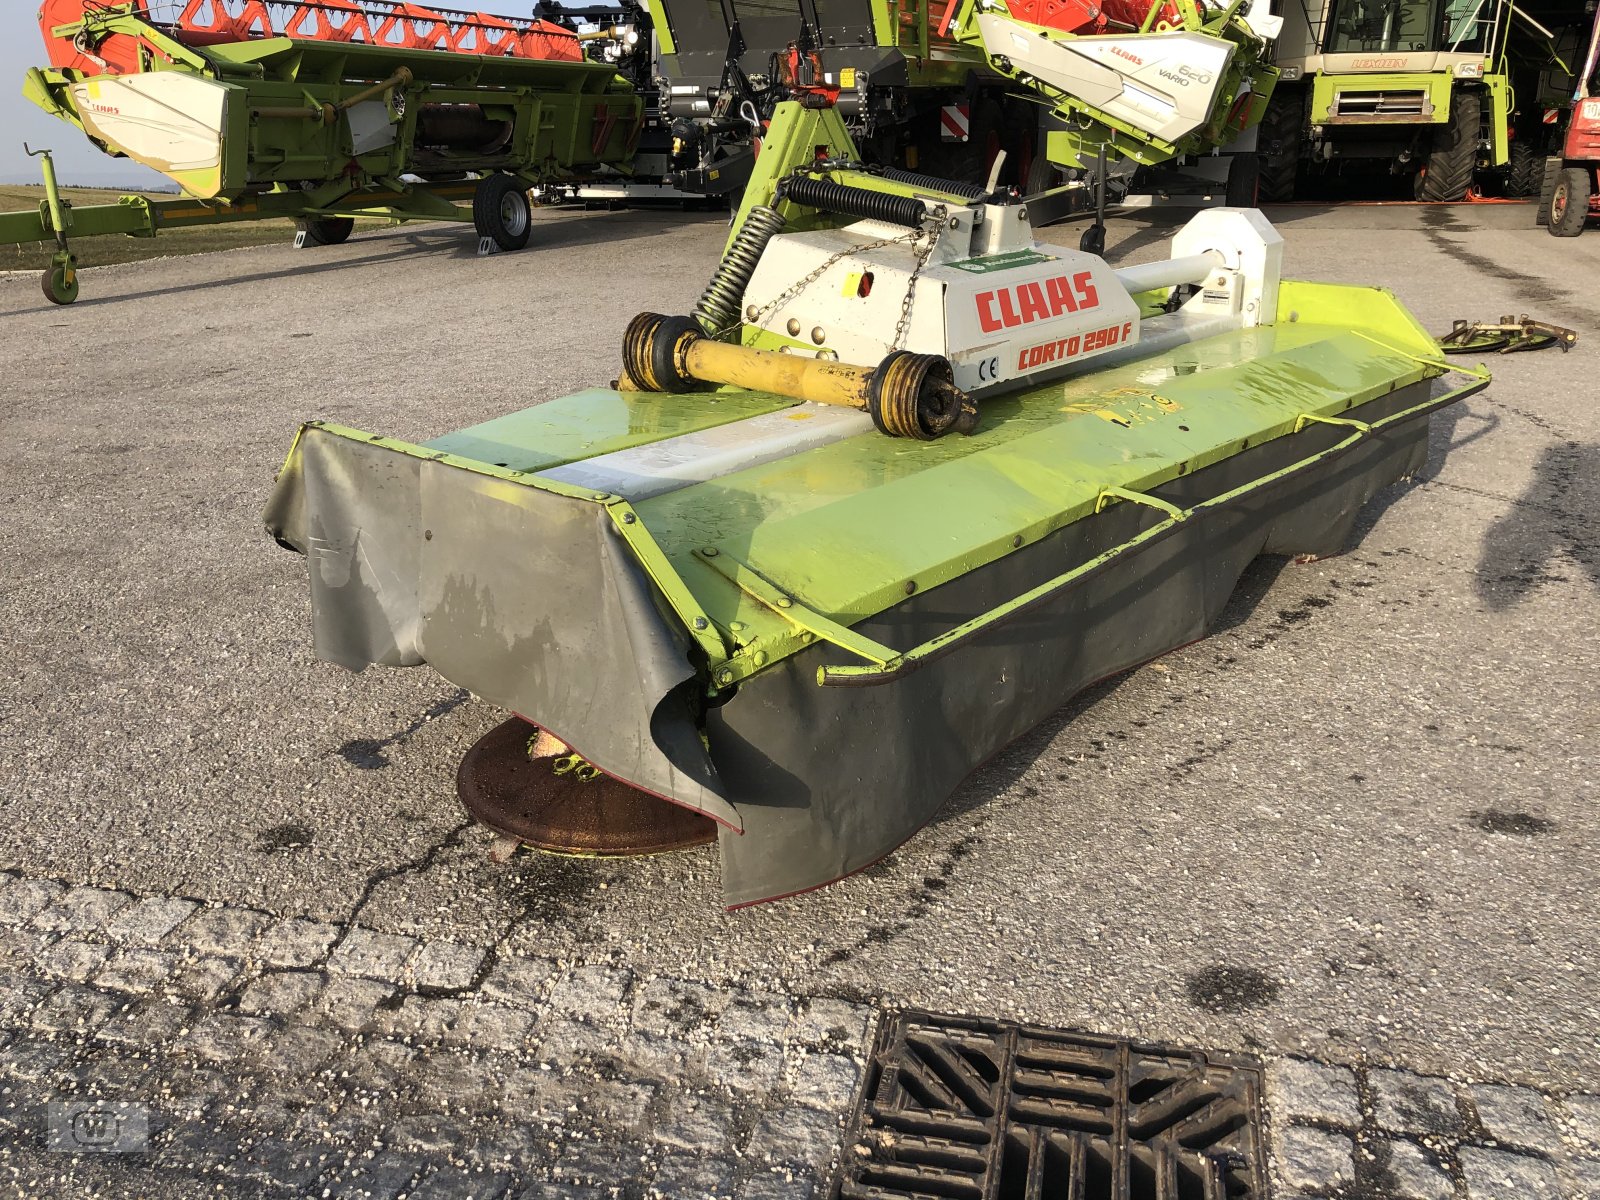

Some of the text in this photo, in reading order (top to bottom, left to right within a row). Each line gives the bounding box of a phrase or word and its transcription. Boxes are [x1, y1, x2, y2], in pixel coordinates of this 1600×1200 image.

[1110, 46, 1143, 66] CLAAS
[1350, 58, 1408, 69] LEXION
[1159, 69, 1190, 87] VARIO
[1178, 65, 1212, 85] 620
[975, 271, 1099, 333] CLAAS
[1018, 322, 1132, 371] CORTO 290 F
